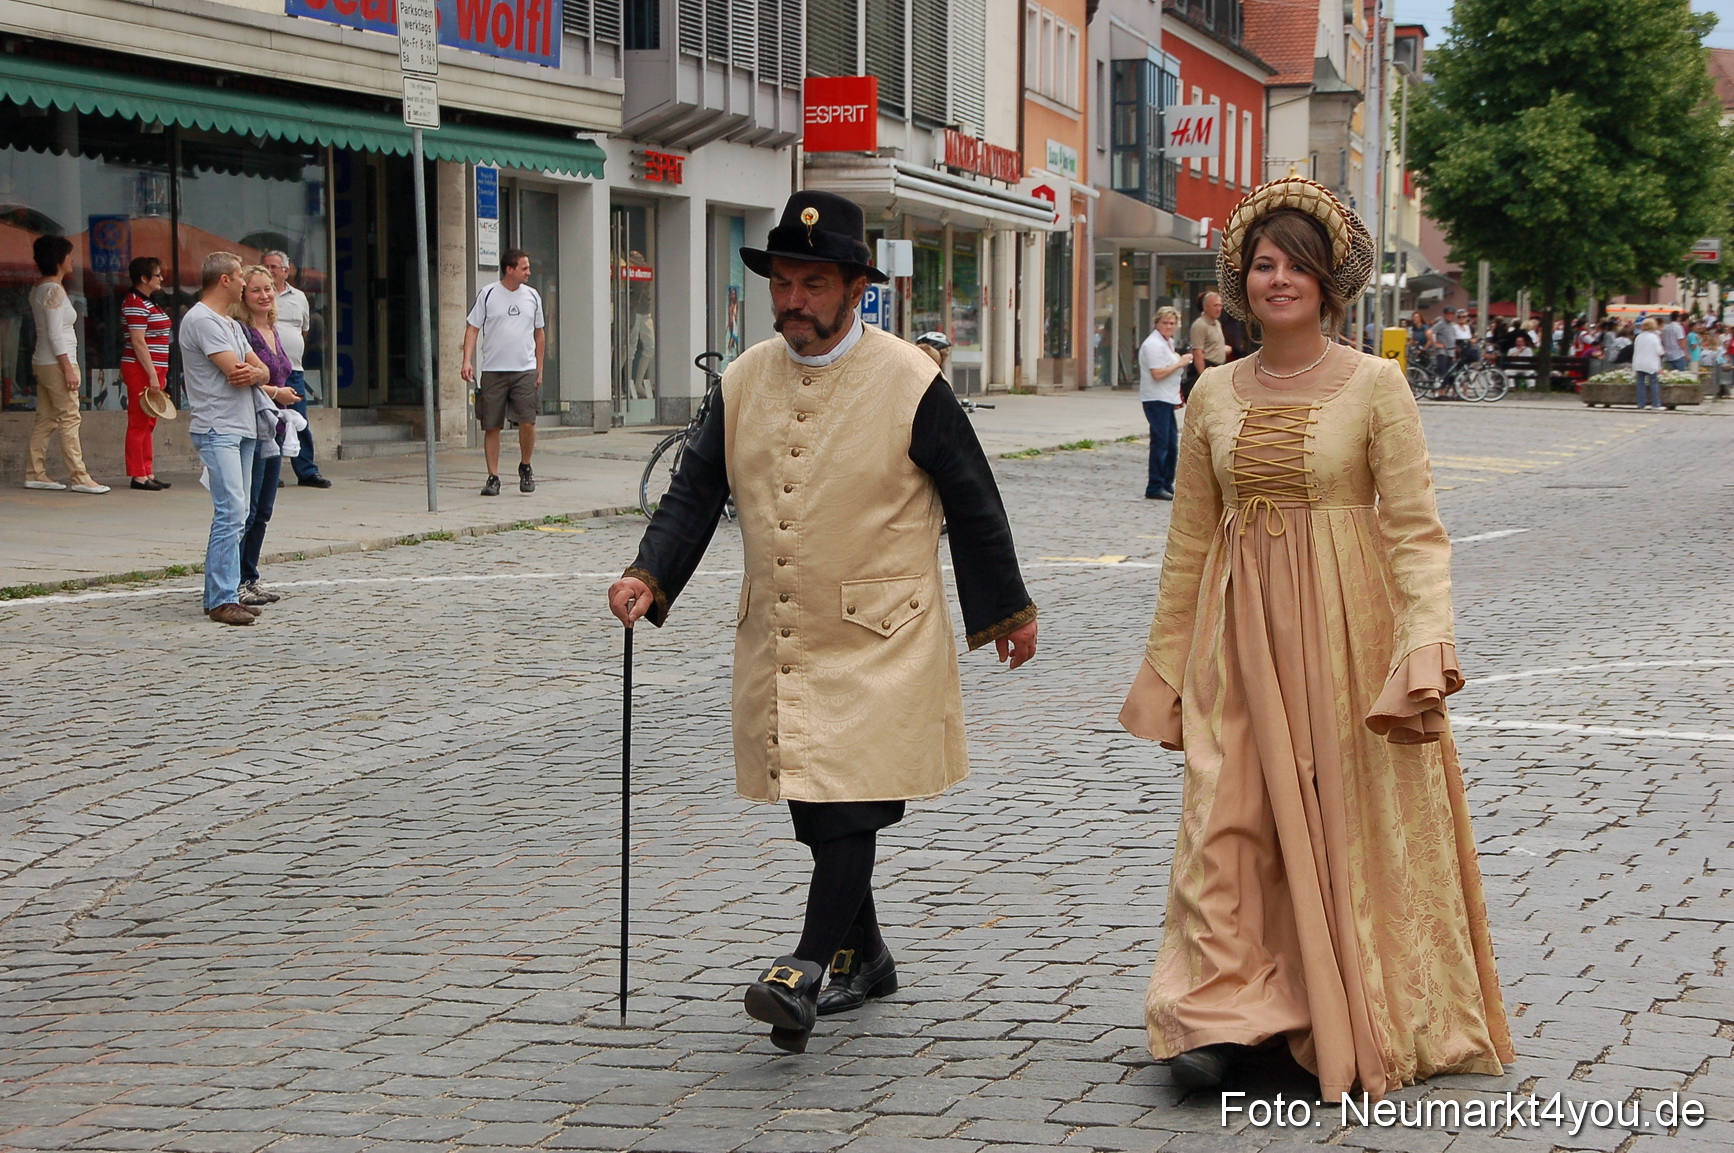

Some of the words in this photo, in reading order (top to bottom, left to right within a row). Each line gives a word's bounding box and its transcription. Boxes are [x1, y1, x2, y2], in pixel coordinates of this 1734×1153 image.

[400, 2, 434, 18] Parkschein
[404, 21, 431, 35] werktags
[402, 36, 418, 48] Mo-Fr
[402, 51, 410, 62] Sa
[805, 104, 869, 124] ESPRIT
[1171, 116, 1214, 147] H&M
[642, 150, 686, 185] ESPRIT
[864, 290, 877, 309] P
